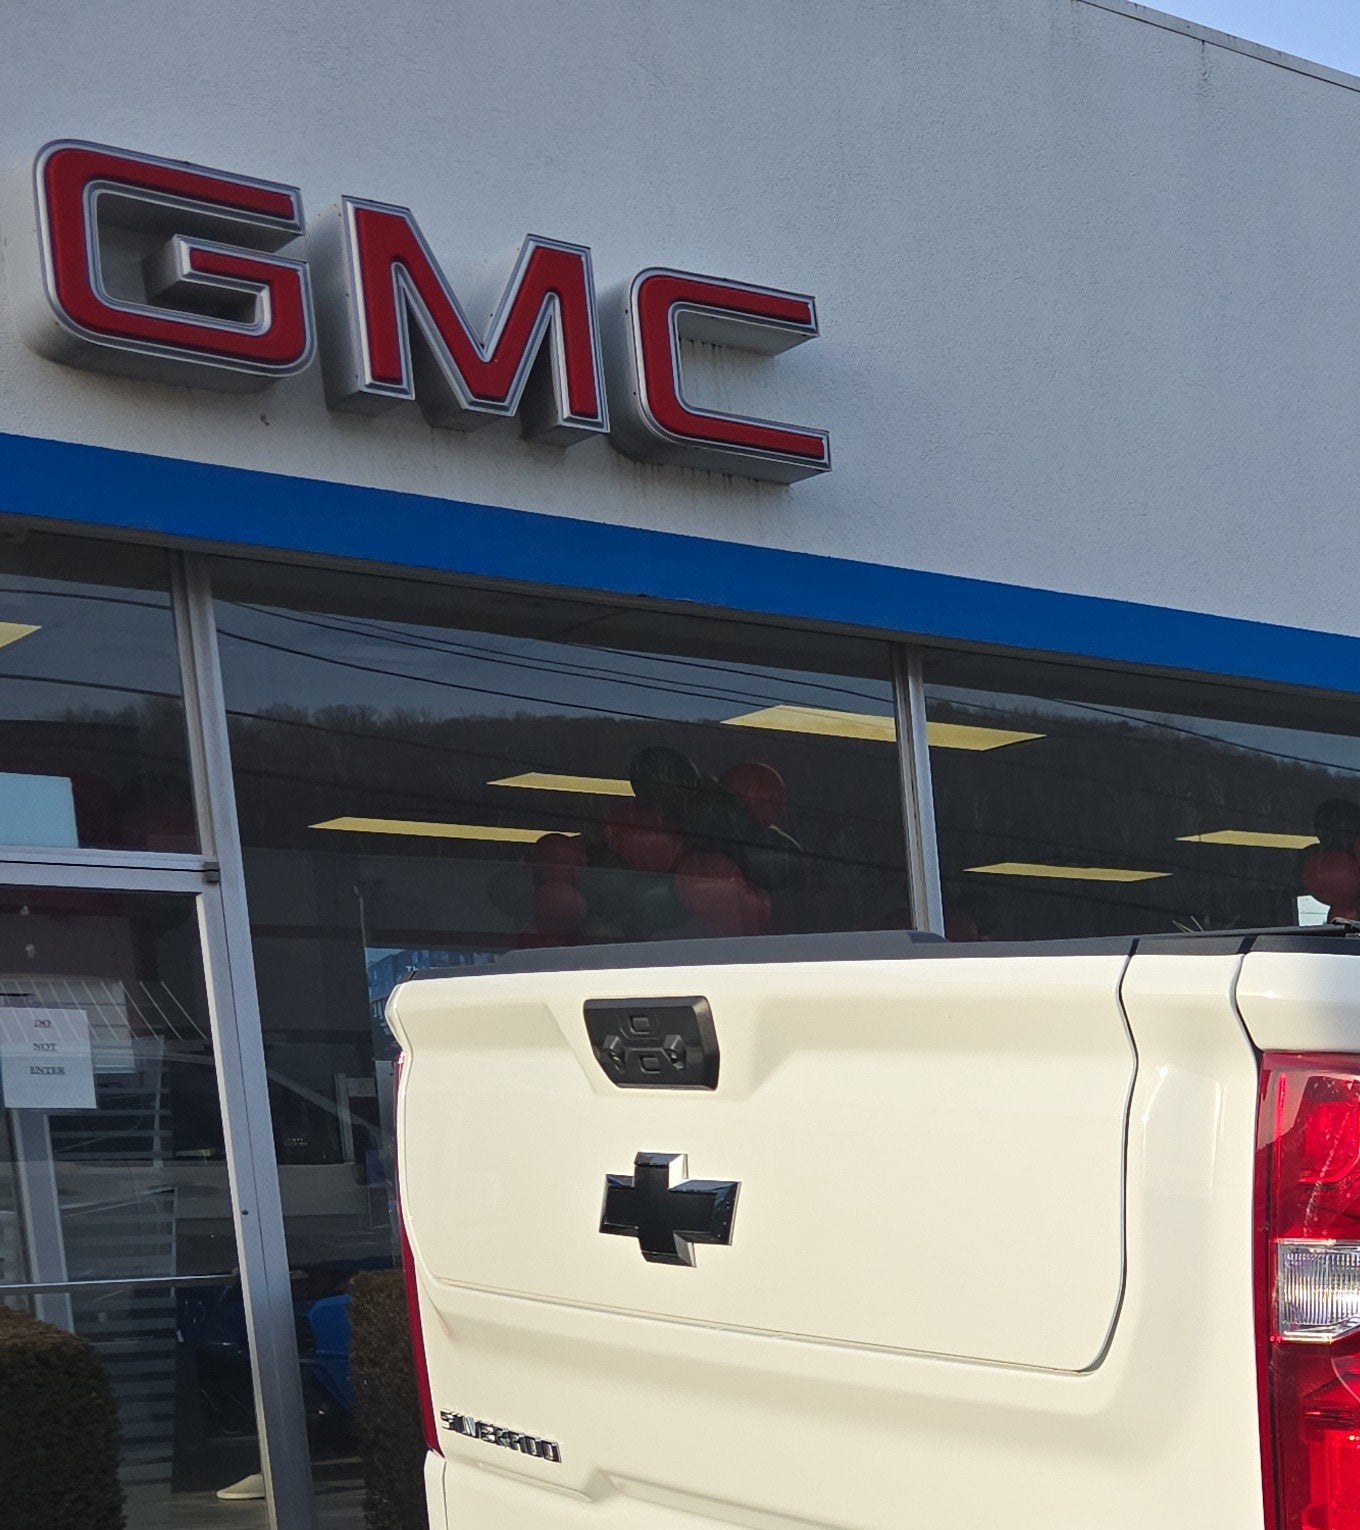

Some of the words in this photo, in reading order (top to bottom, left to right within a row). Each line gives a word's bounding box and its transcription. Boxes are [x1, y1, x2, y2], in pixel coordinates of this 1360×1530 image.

[30, 138, 833, 482] GMC
[34, 1019, 52, 1029] DO
[33, 1042, 58, 1052] NOT
[29, 1066, 66, 1076] ENTER
[439, 1408, 562, 1463] SILVERADO
